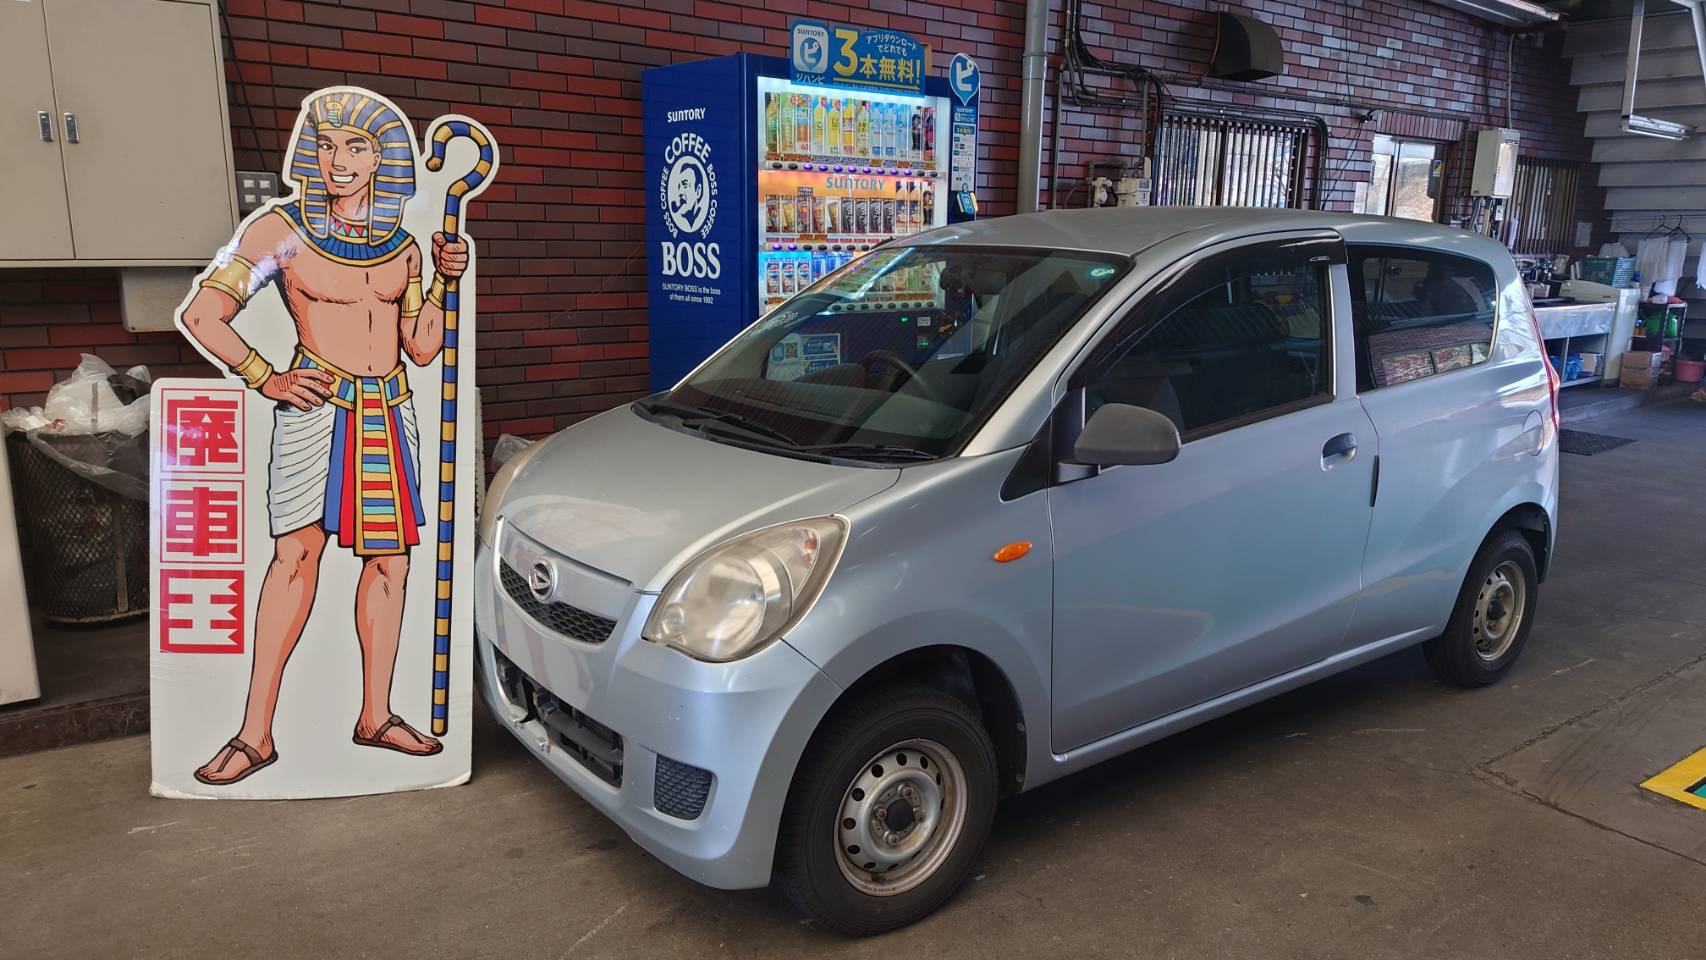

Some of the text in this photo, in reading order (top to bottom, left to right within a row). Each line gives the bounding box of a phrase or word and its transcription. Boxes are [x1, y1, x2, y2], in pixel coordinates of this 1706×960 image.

[797, 28, 825, 37] SUNTORY
[865, 34, 917, 51] アプリダウンロード
[877, 44, 908, 57] でどれでも
[667, 107, 706, 123] SUNTORY
[665, 133, 711, 164] COFFEE
[826, 176, 885, 191] SUNTORY
[660, 166, 678, 239] BOSS COFFEE
[701, 163, 718, 240] BOSS COFFEE
[661, 241, 721, 279] BOSS
[662, 283, 684, 291] SUNTORY
[684, 284, 697, 293] BOSS
[710, 287, 721, 295] boss
[691, 295, 702, 303] since
[703, 296, 714, 304] 1992
[165, 395, 239, 646] 廃車王
